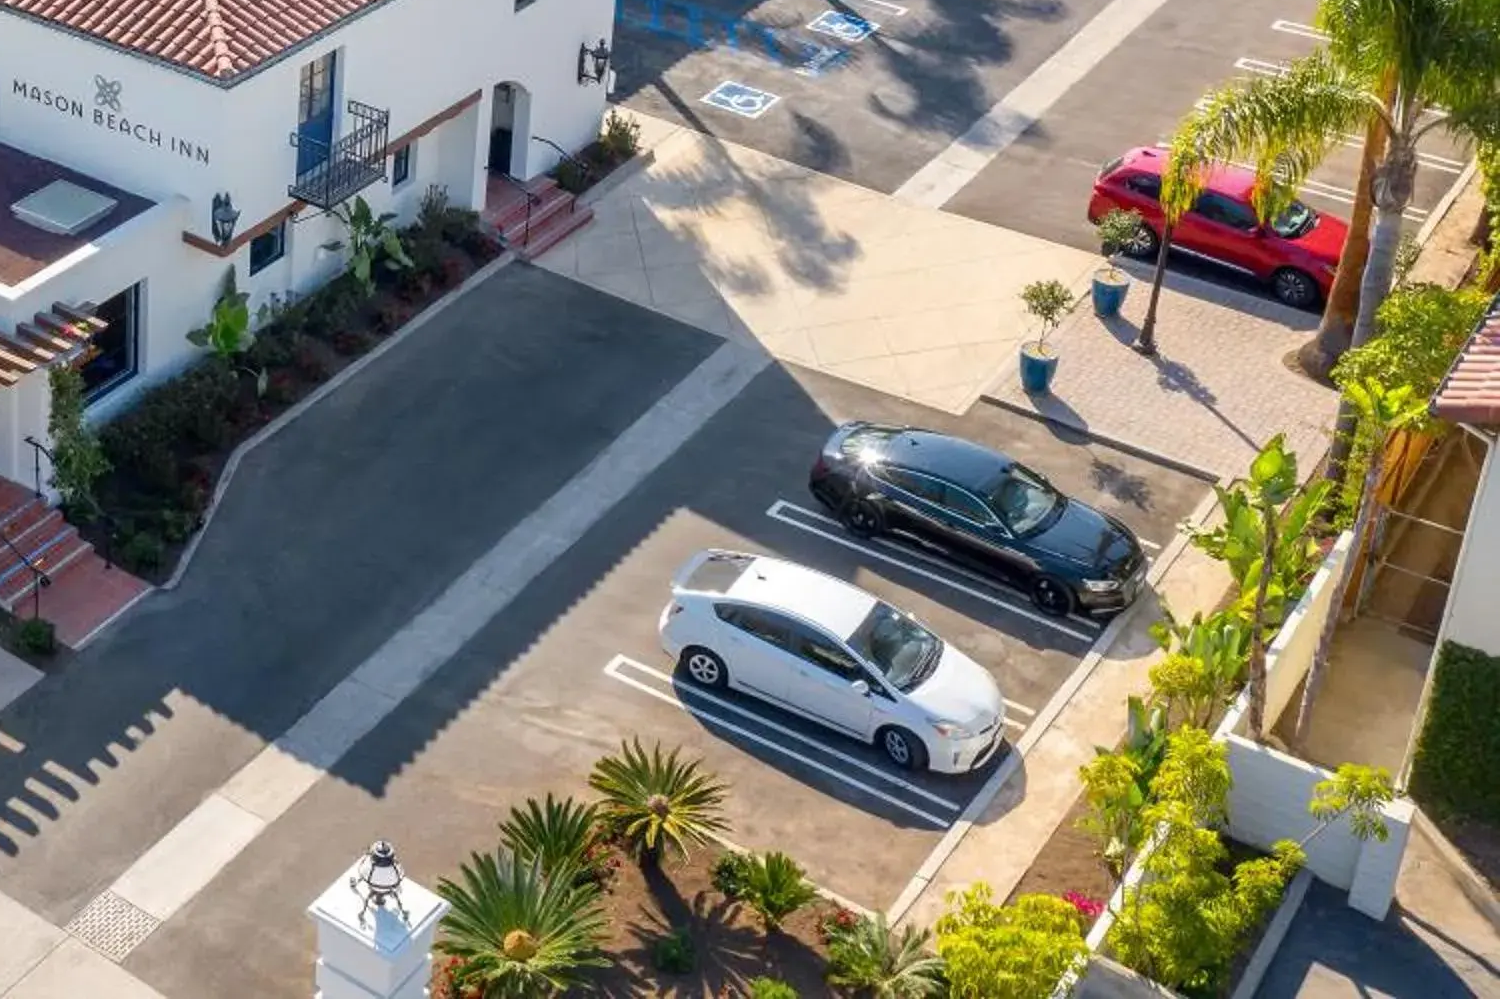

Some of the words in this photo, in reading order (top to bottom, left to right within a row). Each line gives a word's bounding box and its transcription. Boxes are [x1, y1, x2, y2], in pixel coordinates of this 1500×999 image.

[12, 79, 83, 118] MASON
[93, 108, 161, 147] BEACH
[171, 136, 210, 165] INN
